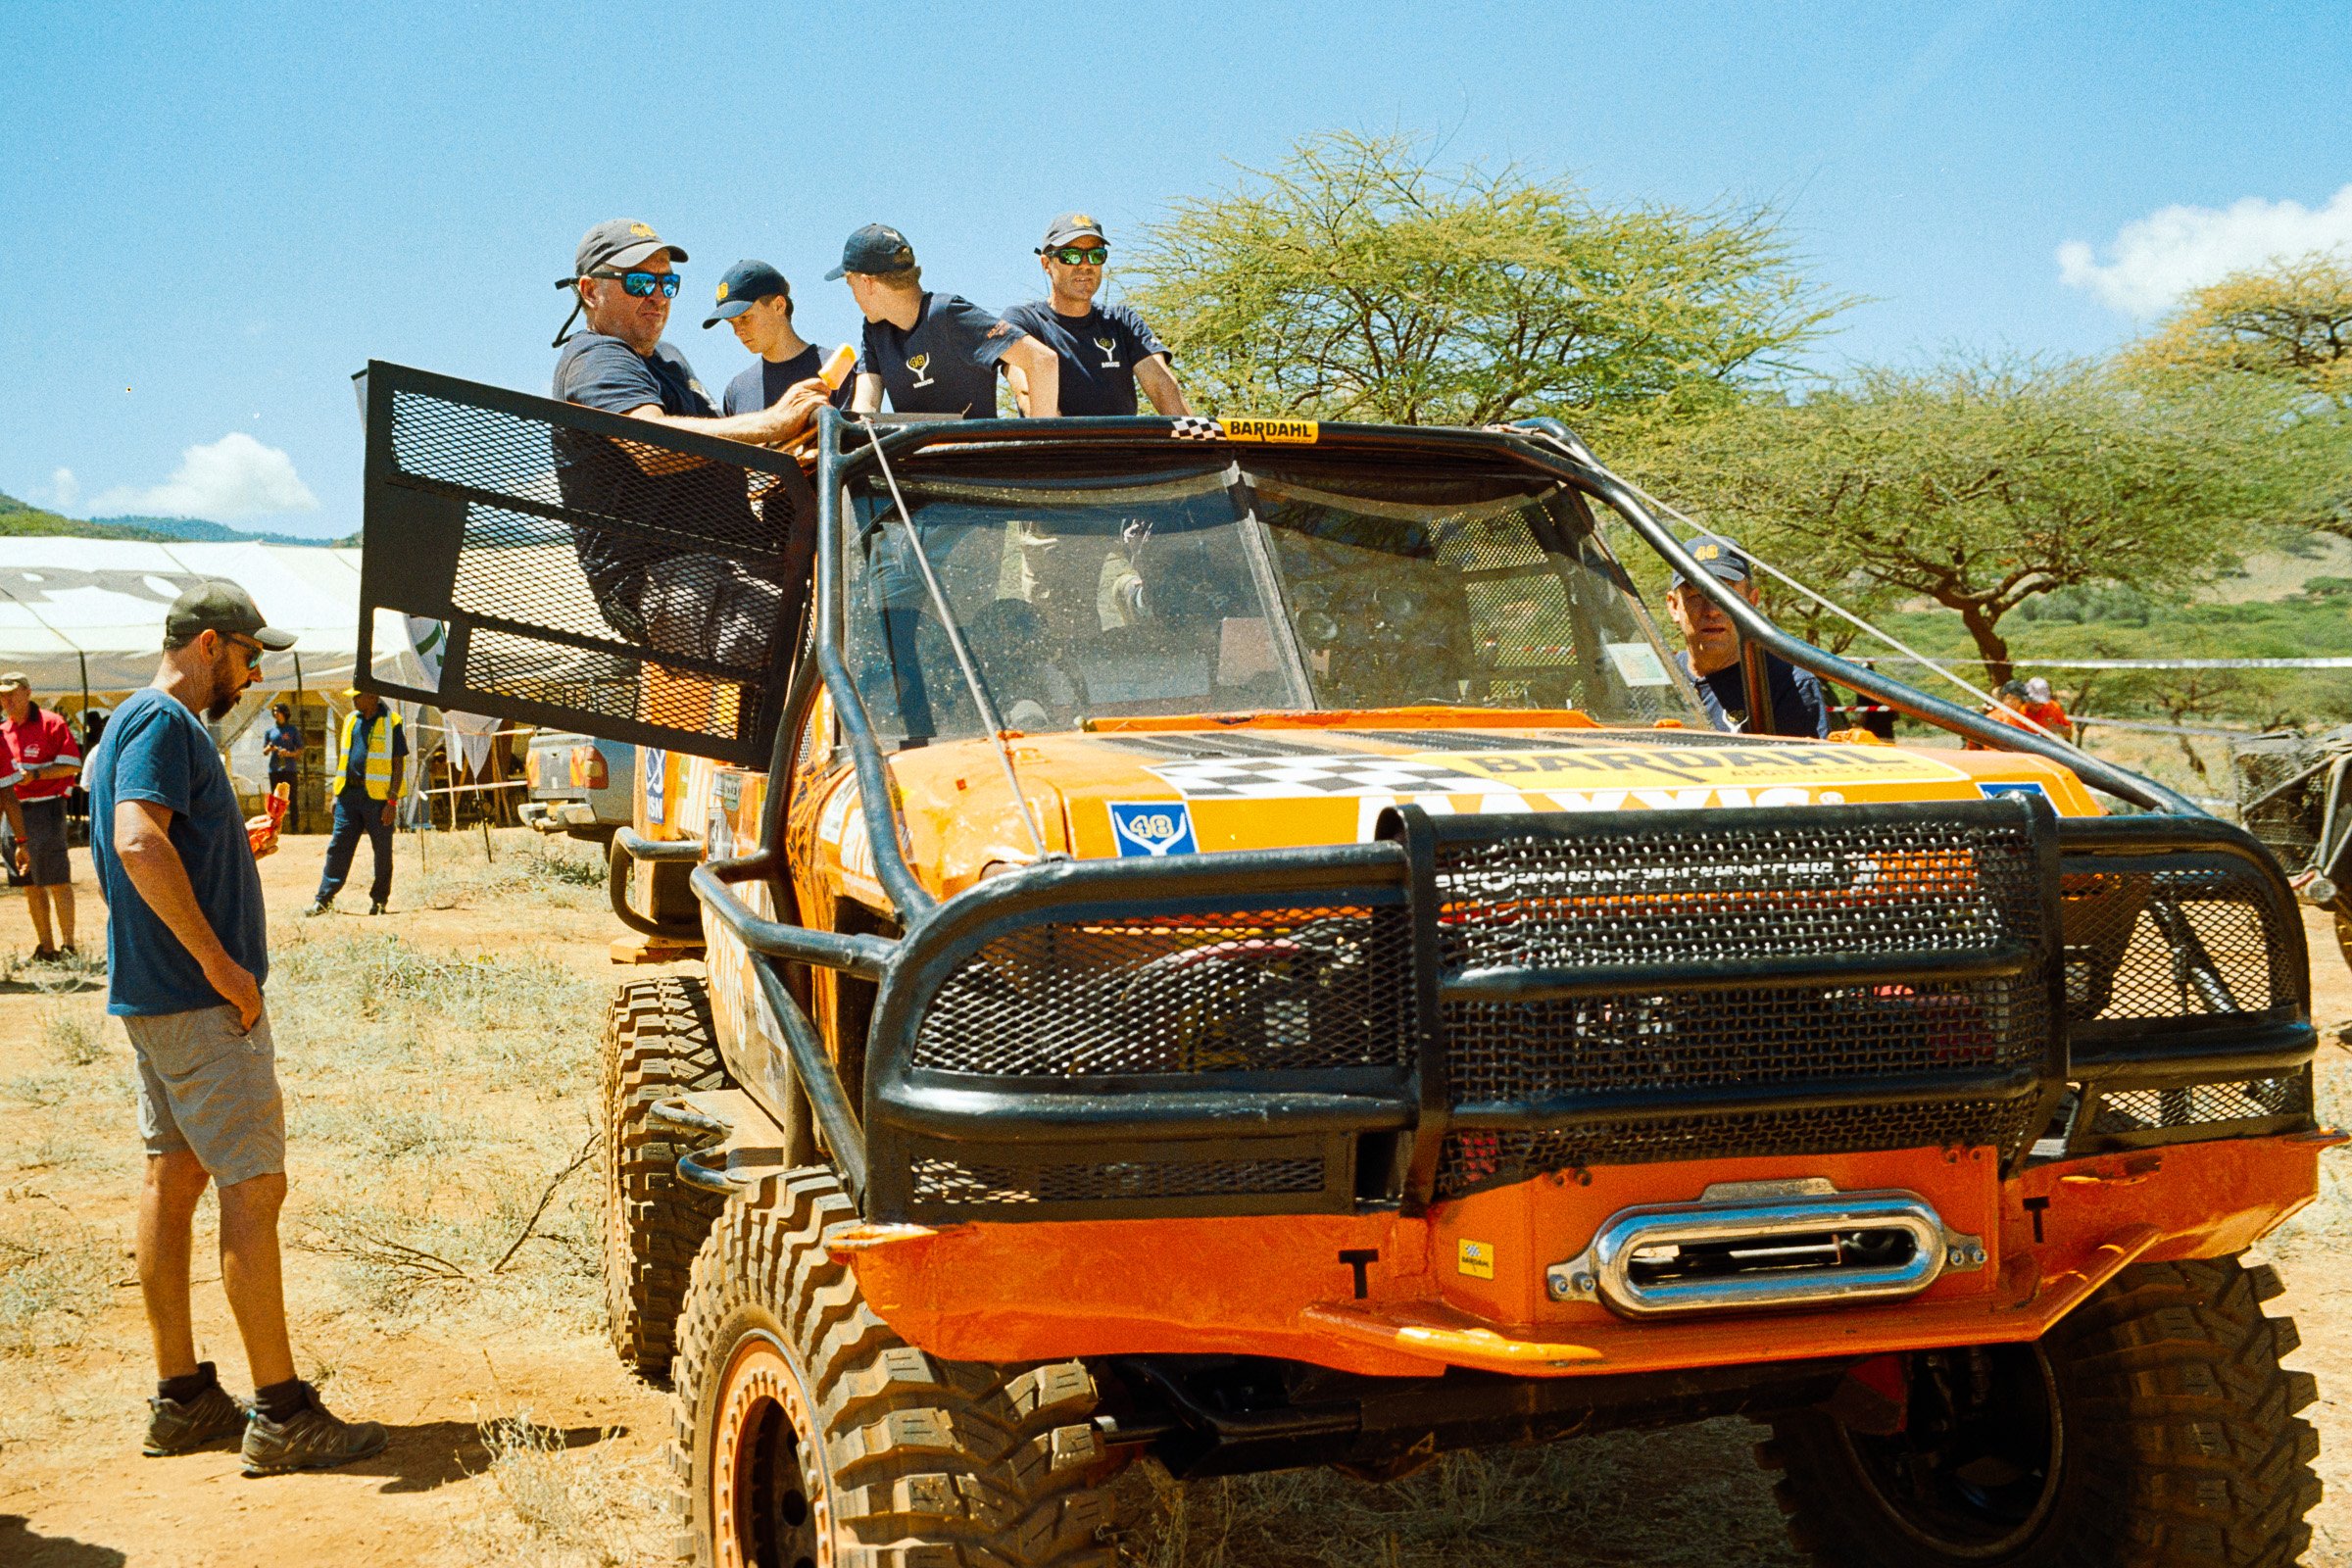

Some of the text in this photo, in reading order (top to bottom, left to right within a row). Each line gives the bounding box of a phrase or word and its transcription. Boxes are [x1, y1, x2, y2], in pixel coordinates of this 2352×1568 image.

[1230, 421, 1312, 442] BARDAHL
[1693, 544, 1718, 561] 48
[1464, 750, 1909, 783] BARDAHL
[1129, 814, 1174, 838] 48
[2023, 1196, 2050, 1244] T
[1338, 1249, 1379, 1299] T
